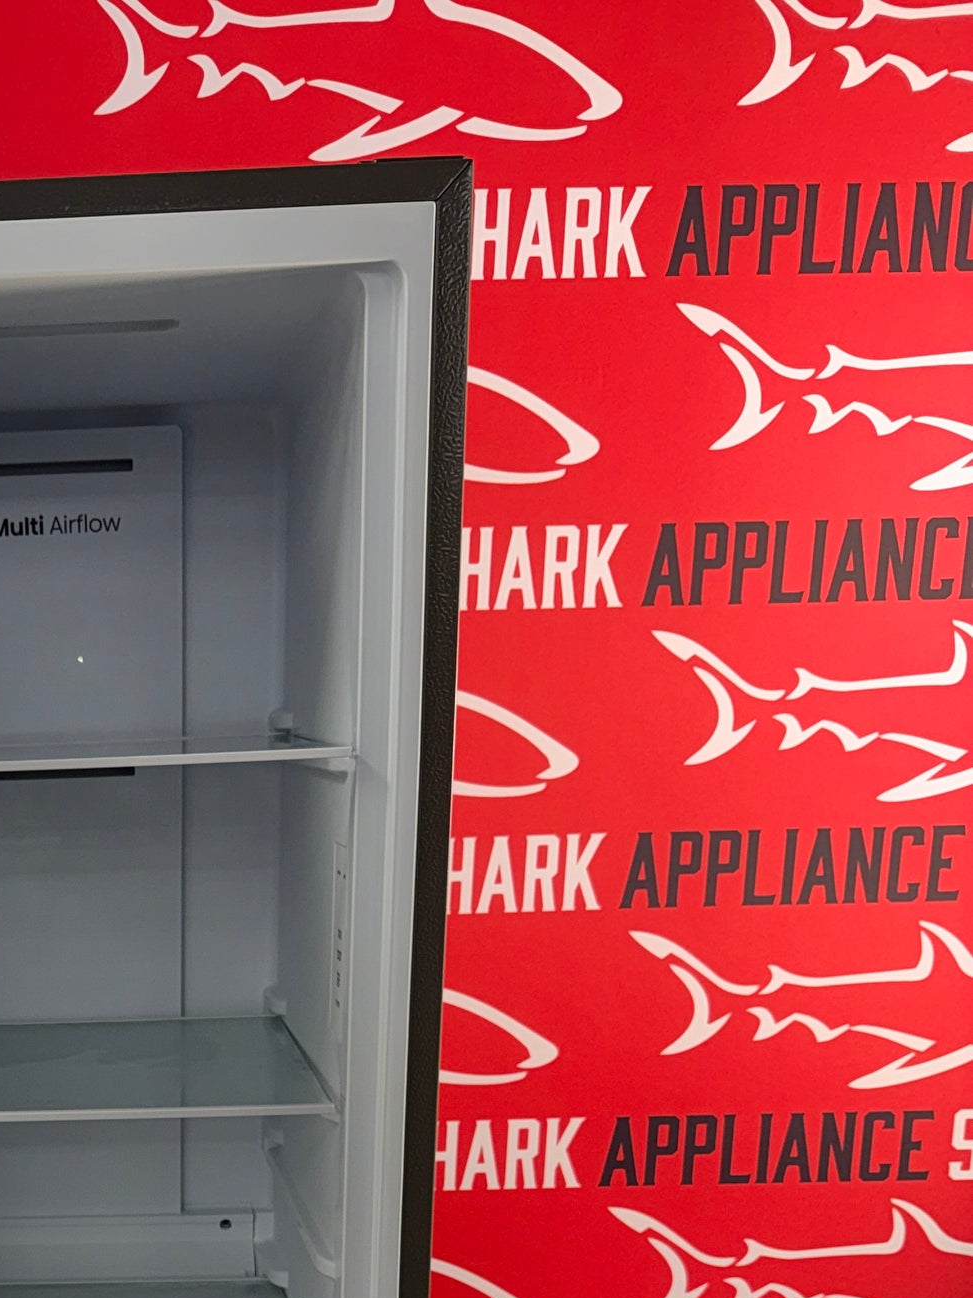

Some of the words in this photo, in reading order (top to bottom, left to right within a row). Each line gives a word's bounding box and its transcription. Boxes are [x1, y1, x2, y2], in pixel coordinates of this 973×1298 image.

[49, 514, 122, 536] Airflow
[619, 825, 966, 908] APPLIANCE
[598, 1111, 935, 1187] APPLIANCE
